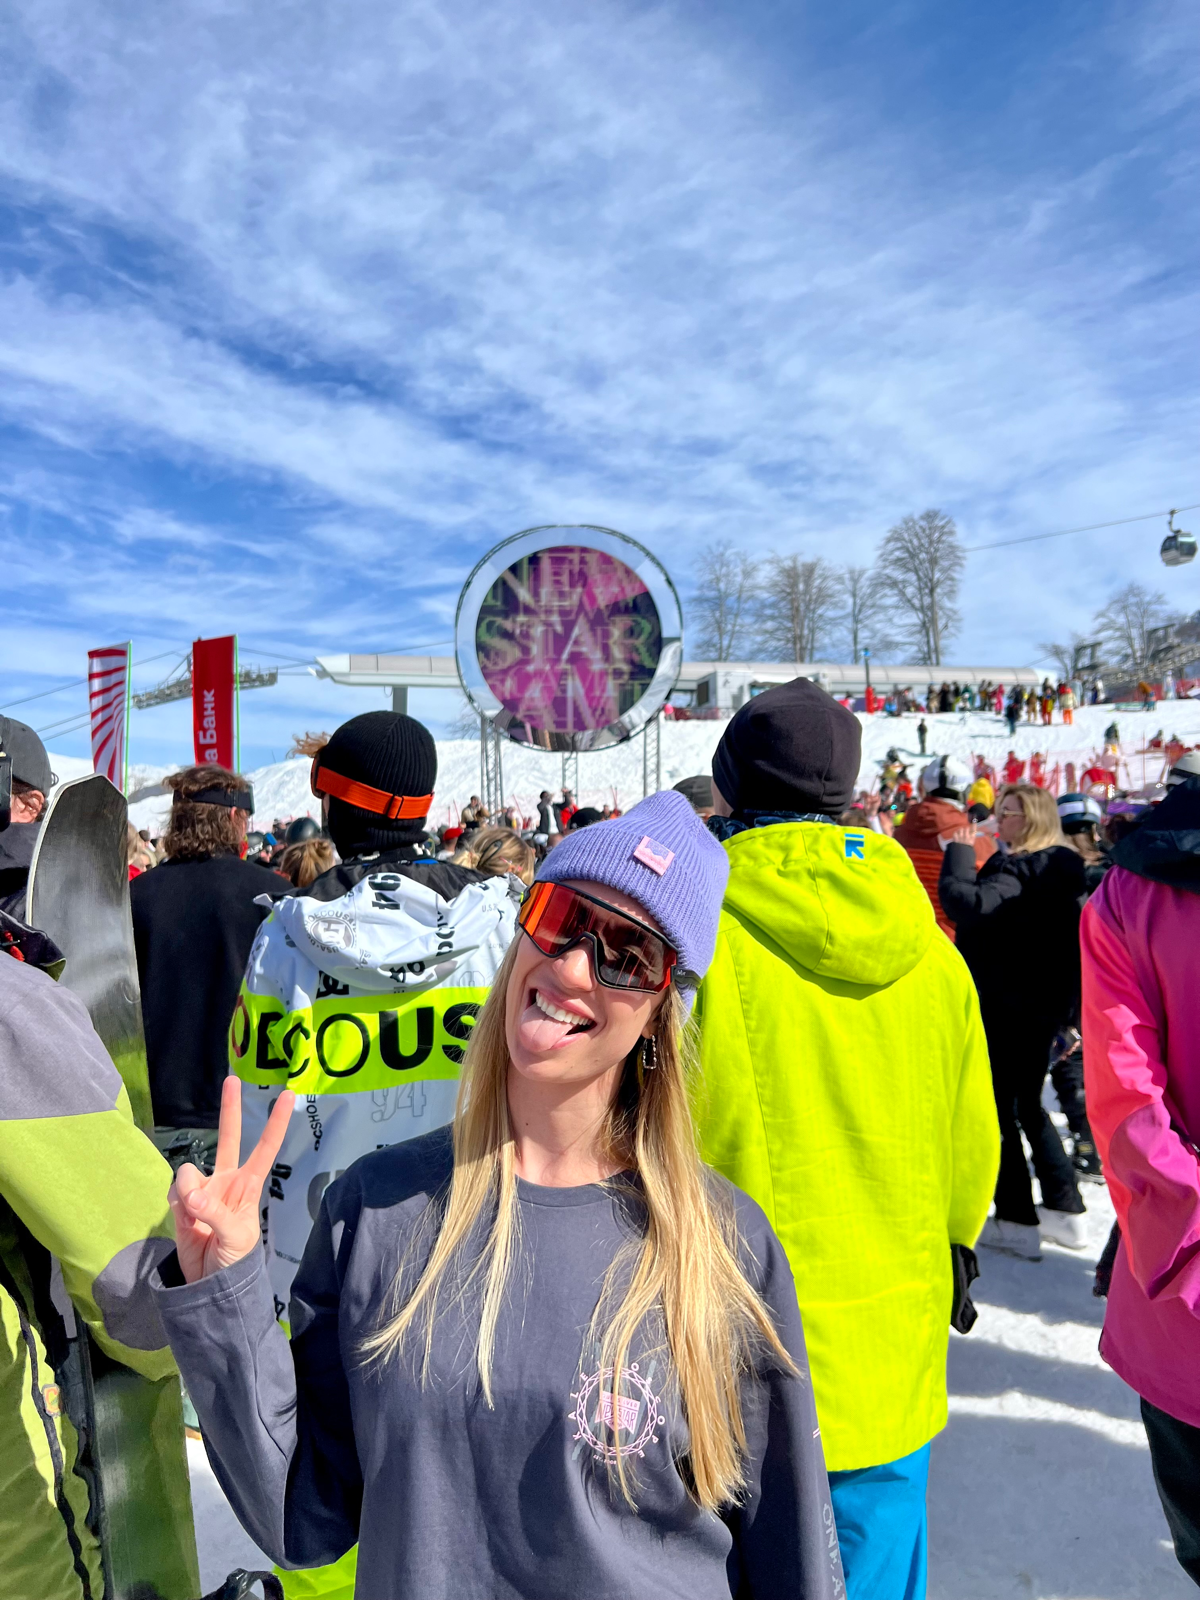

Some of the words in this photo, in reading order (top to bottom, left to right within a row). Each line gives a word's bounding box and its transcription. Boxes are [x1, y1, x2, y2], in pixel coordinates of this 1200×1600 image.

[477, 613, 657, 670] STAR
[199, 688, 217, 745] Банк
[568, 1361, 665, 1459] KALEIOCOPE
